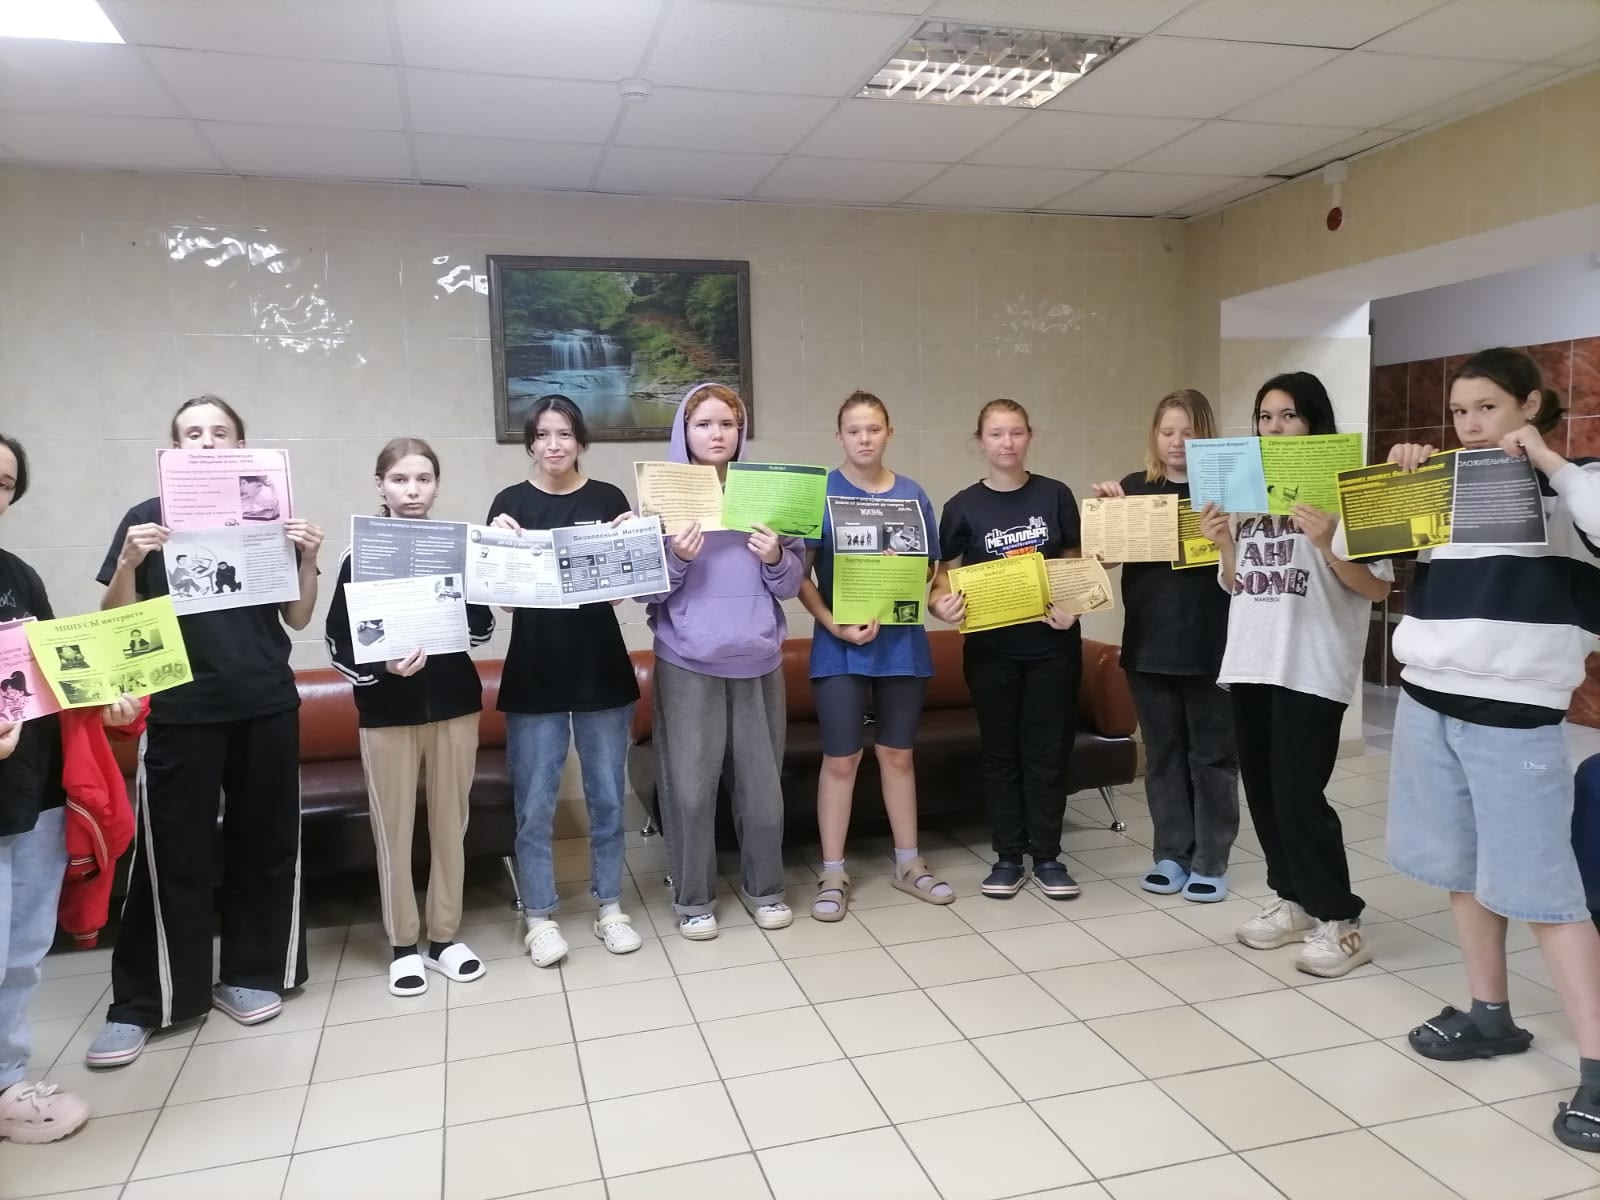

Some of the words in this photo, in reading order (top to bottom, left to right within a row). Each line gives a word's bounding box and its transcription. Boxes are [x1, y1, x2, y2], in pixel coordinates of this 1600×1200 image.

[573, 532, 619, 542] Безопасный
[622, 525, 656, 536] Интернет
[987, 526, 1048, 550] МЕТАЛЛУРГ
[54, 619, 101, 633] МИНУСЫ
